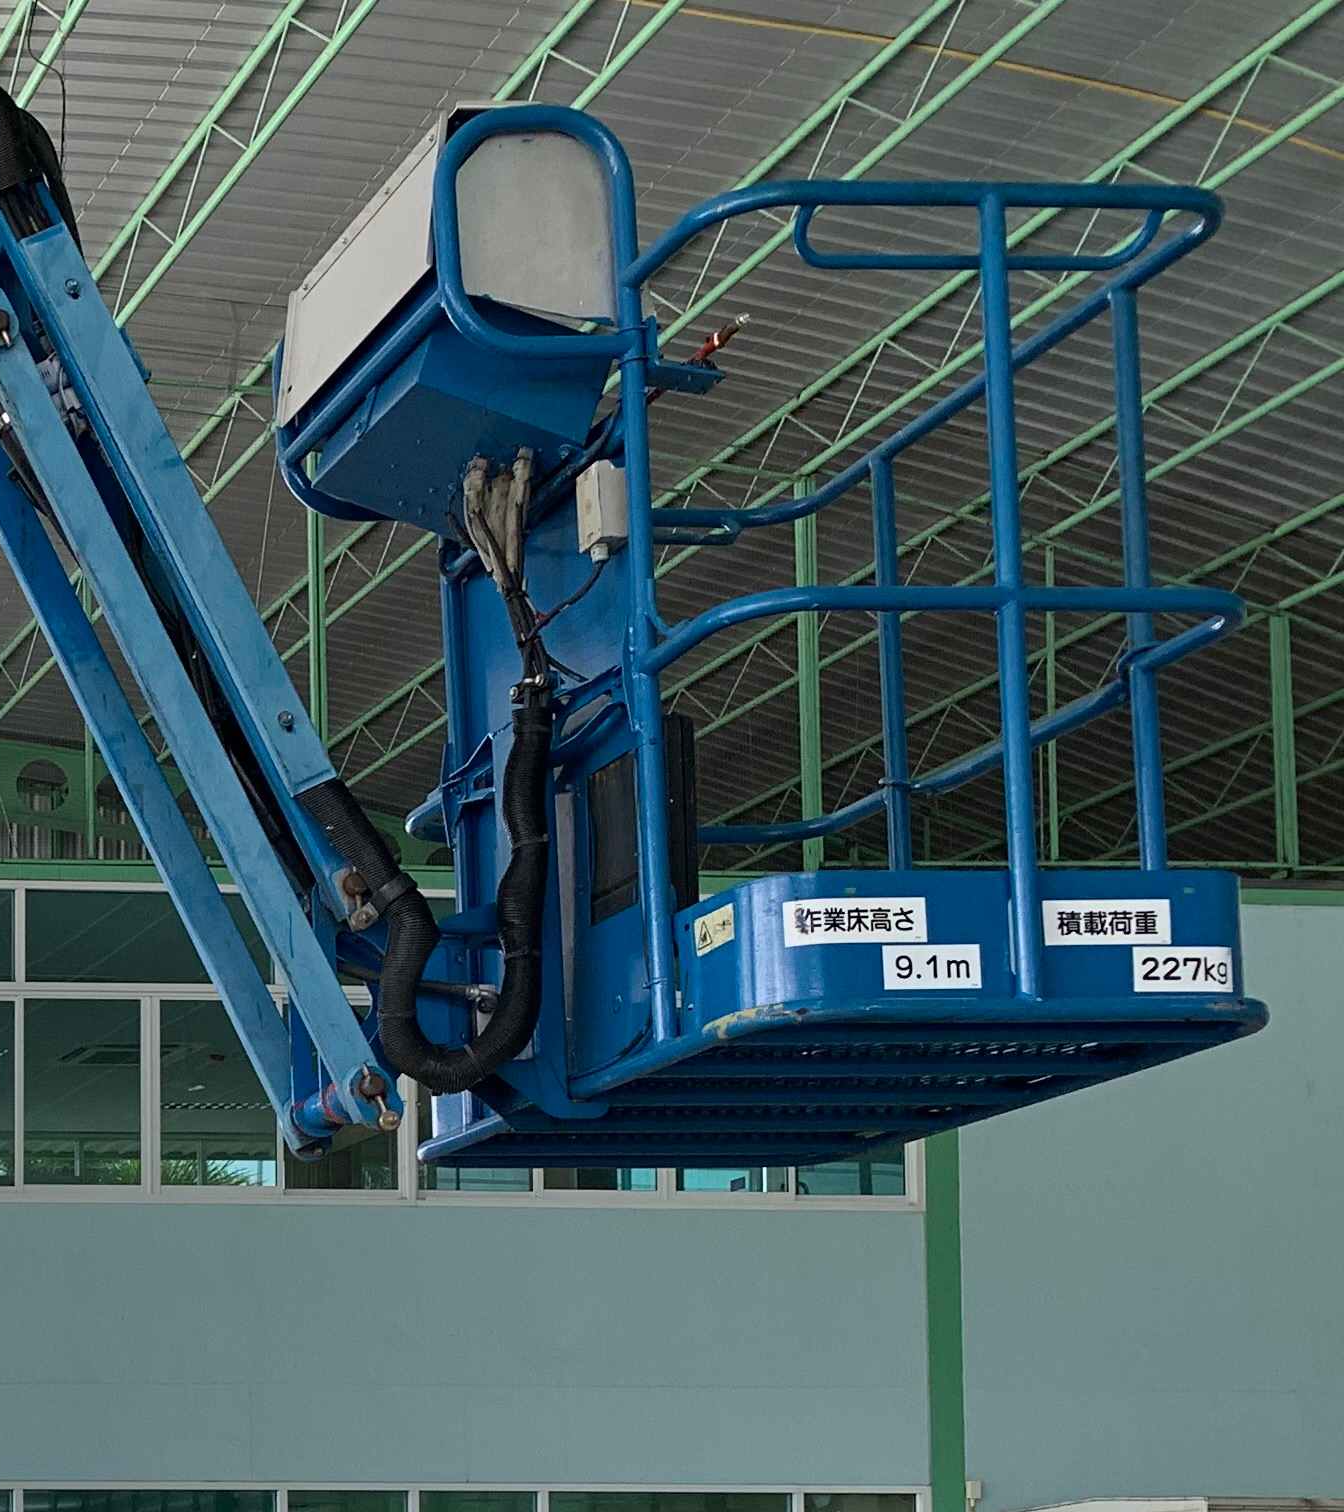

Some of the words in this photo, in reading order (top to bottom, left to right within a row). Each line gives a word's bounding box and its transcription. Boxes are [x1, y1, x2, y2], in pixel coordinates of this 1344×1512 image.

[795, 908, 915, 934] 作業床高さ
[1057, 911, 1159, 935] 積載荷重
[895, 954, 971, 979] 9.1m
[1141, 957, 1227, 985] 227kg
